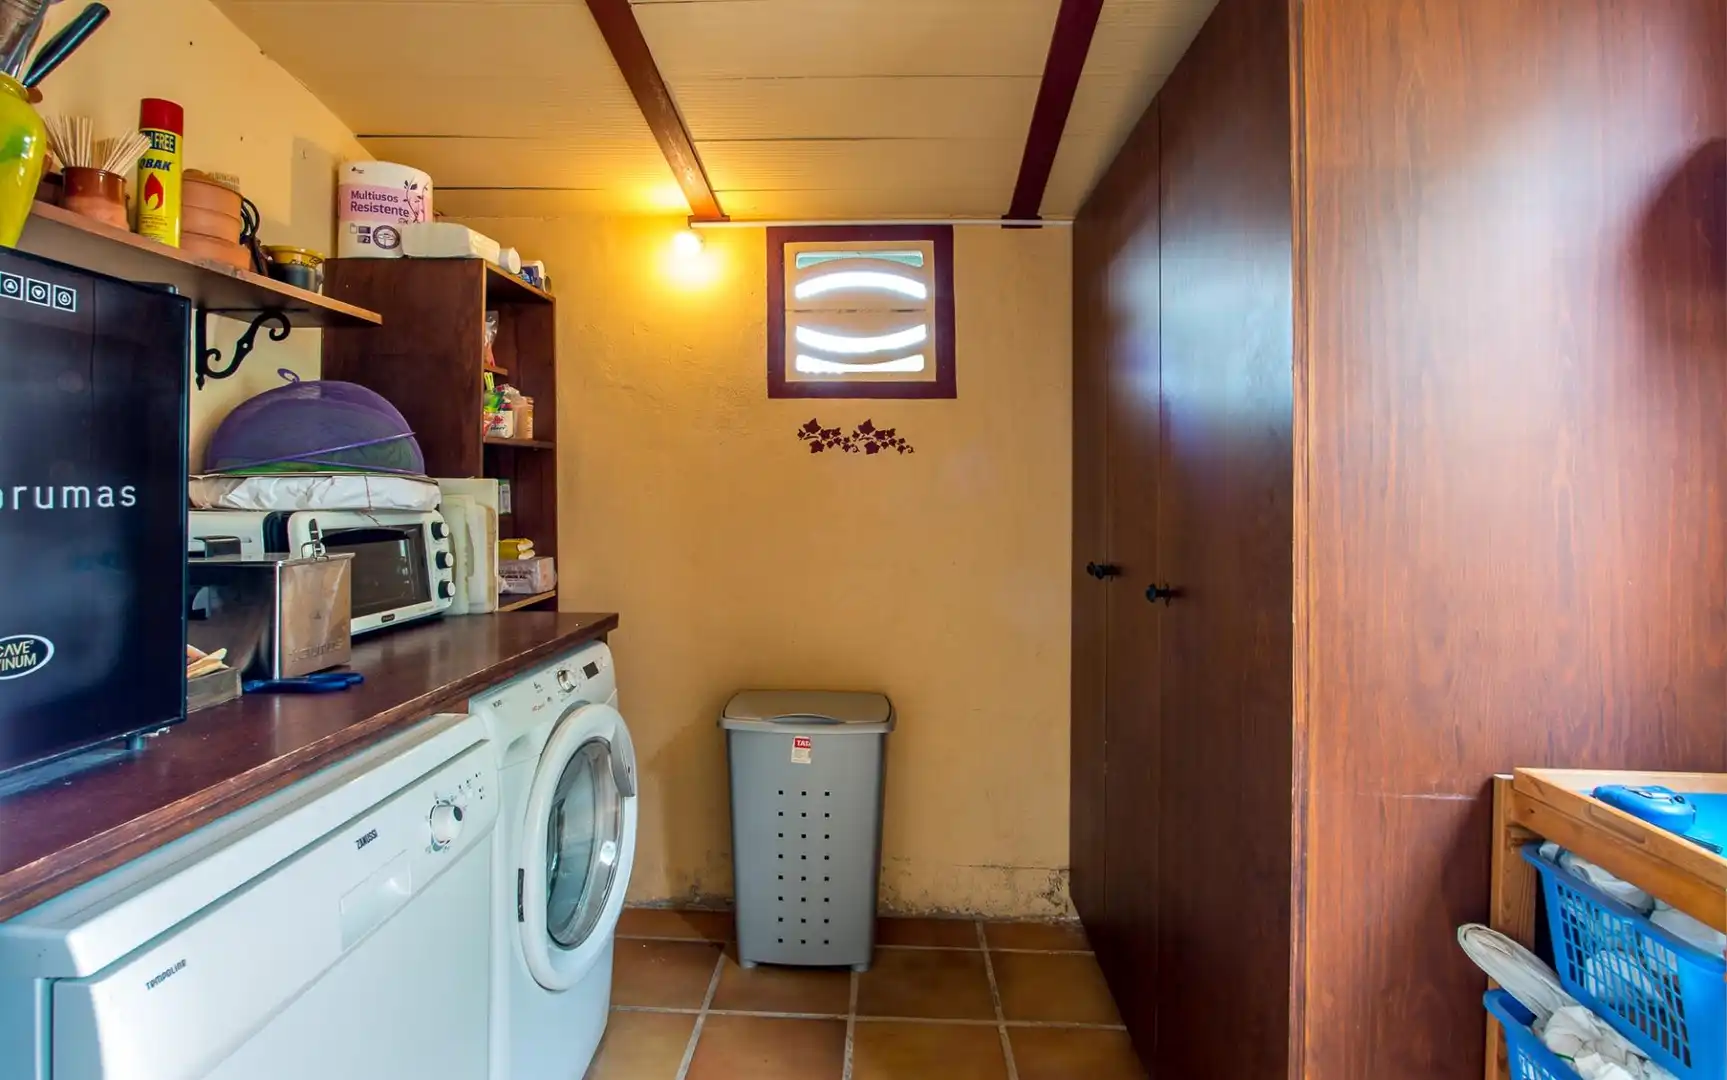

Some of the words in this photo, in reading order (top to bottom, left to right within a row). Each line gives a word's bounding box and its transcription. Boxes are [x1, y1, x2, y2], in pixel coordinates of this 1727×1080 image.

[154, 132, 175, 150] FREE
[350, 190, 399, 203] Multiusos
[350, 201, 410, 217] Resistente
[0, 485, 137, 510] rumas
[355, 829, 378, 850] ZANUSSI
